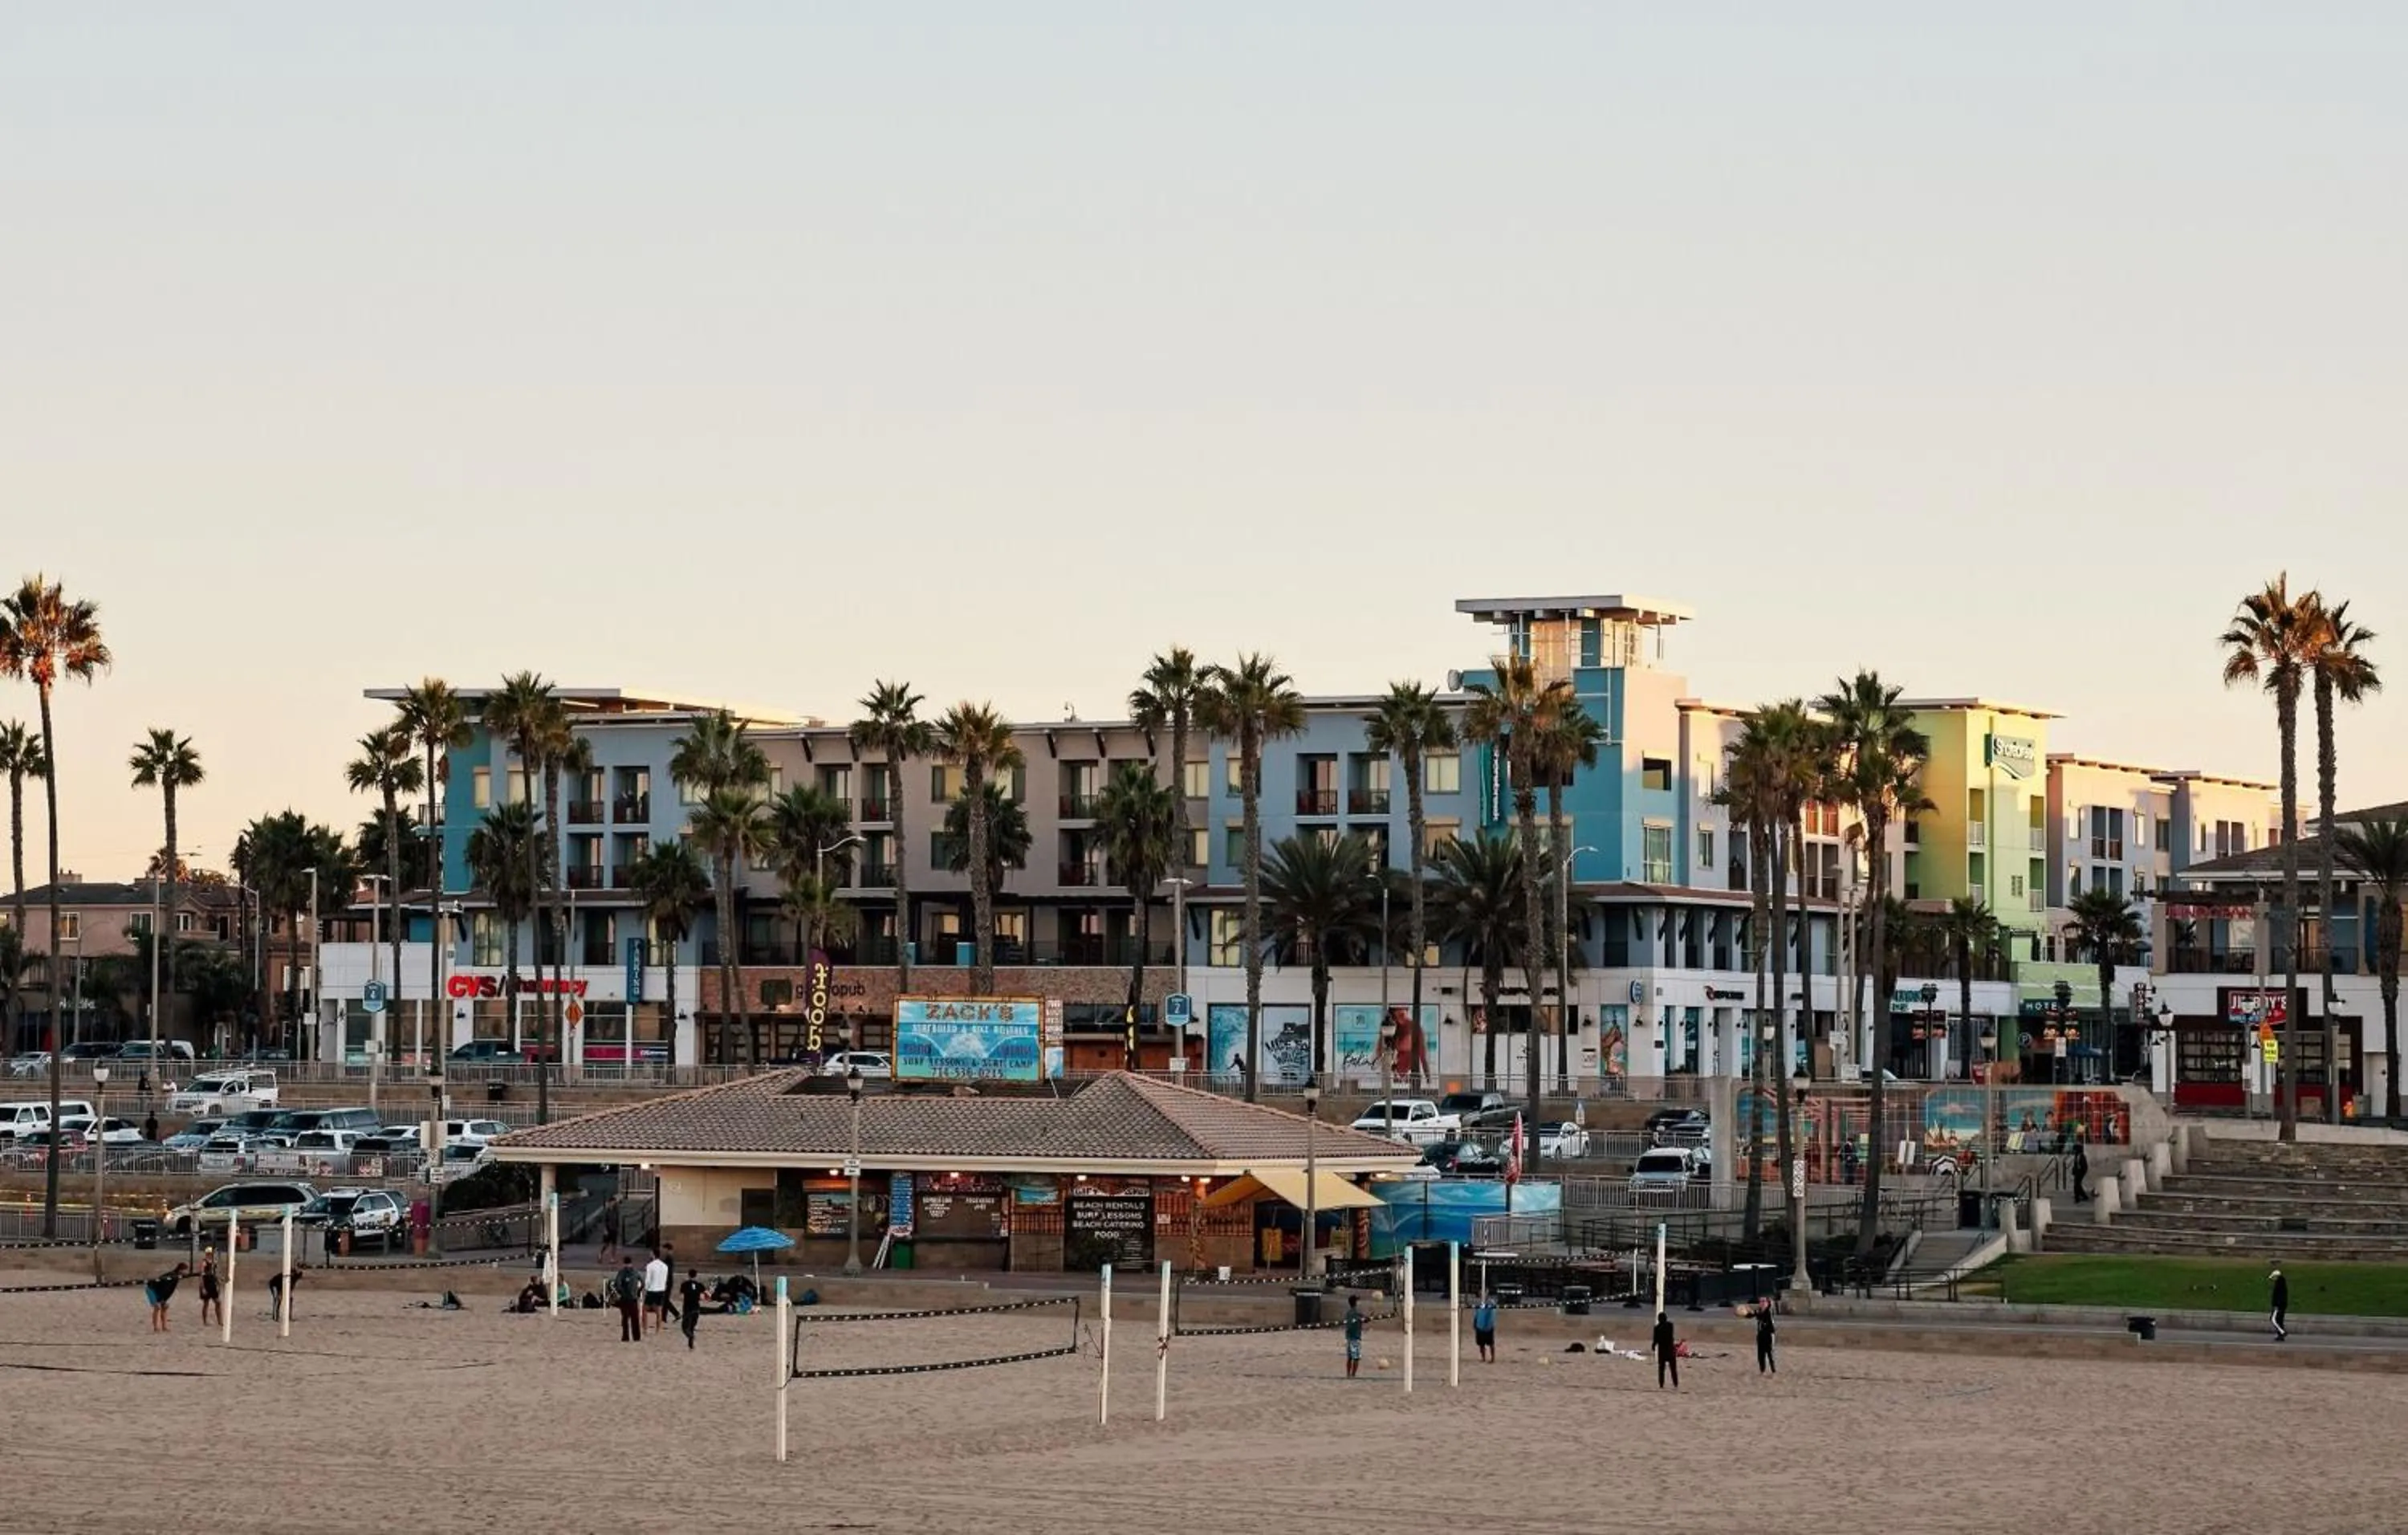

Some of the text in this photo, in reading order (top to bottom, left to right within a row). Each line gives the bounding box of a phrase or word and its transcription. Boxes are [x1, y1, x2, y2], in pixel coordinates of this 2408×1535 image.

[1174, 1003, 1181, 1013] 2
[2026, 1001, 2058, 1011] HOTE
[926, 1004, 1014, 1021] ZACK'S
[903, 1057, 923, 1065] SURF
[929, 1057, 965, 1067] LESSONS
[1010, 1060, 1033, 1069] CAMP
[1073, 1201, 1145, 1210] BEACH RENTALS
[1076, 1211, 1142, 1219] SURF LESSONS
[1072, 1220, 1145, 1229] BEACH CATERING
[1094, 1231, 1120, 1239] FOOD
